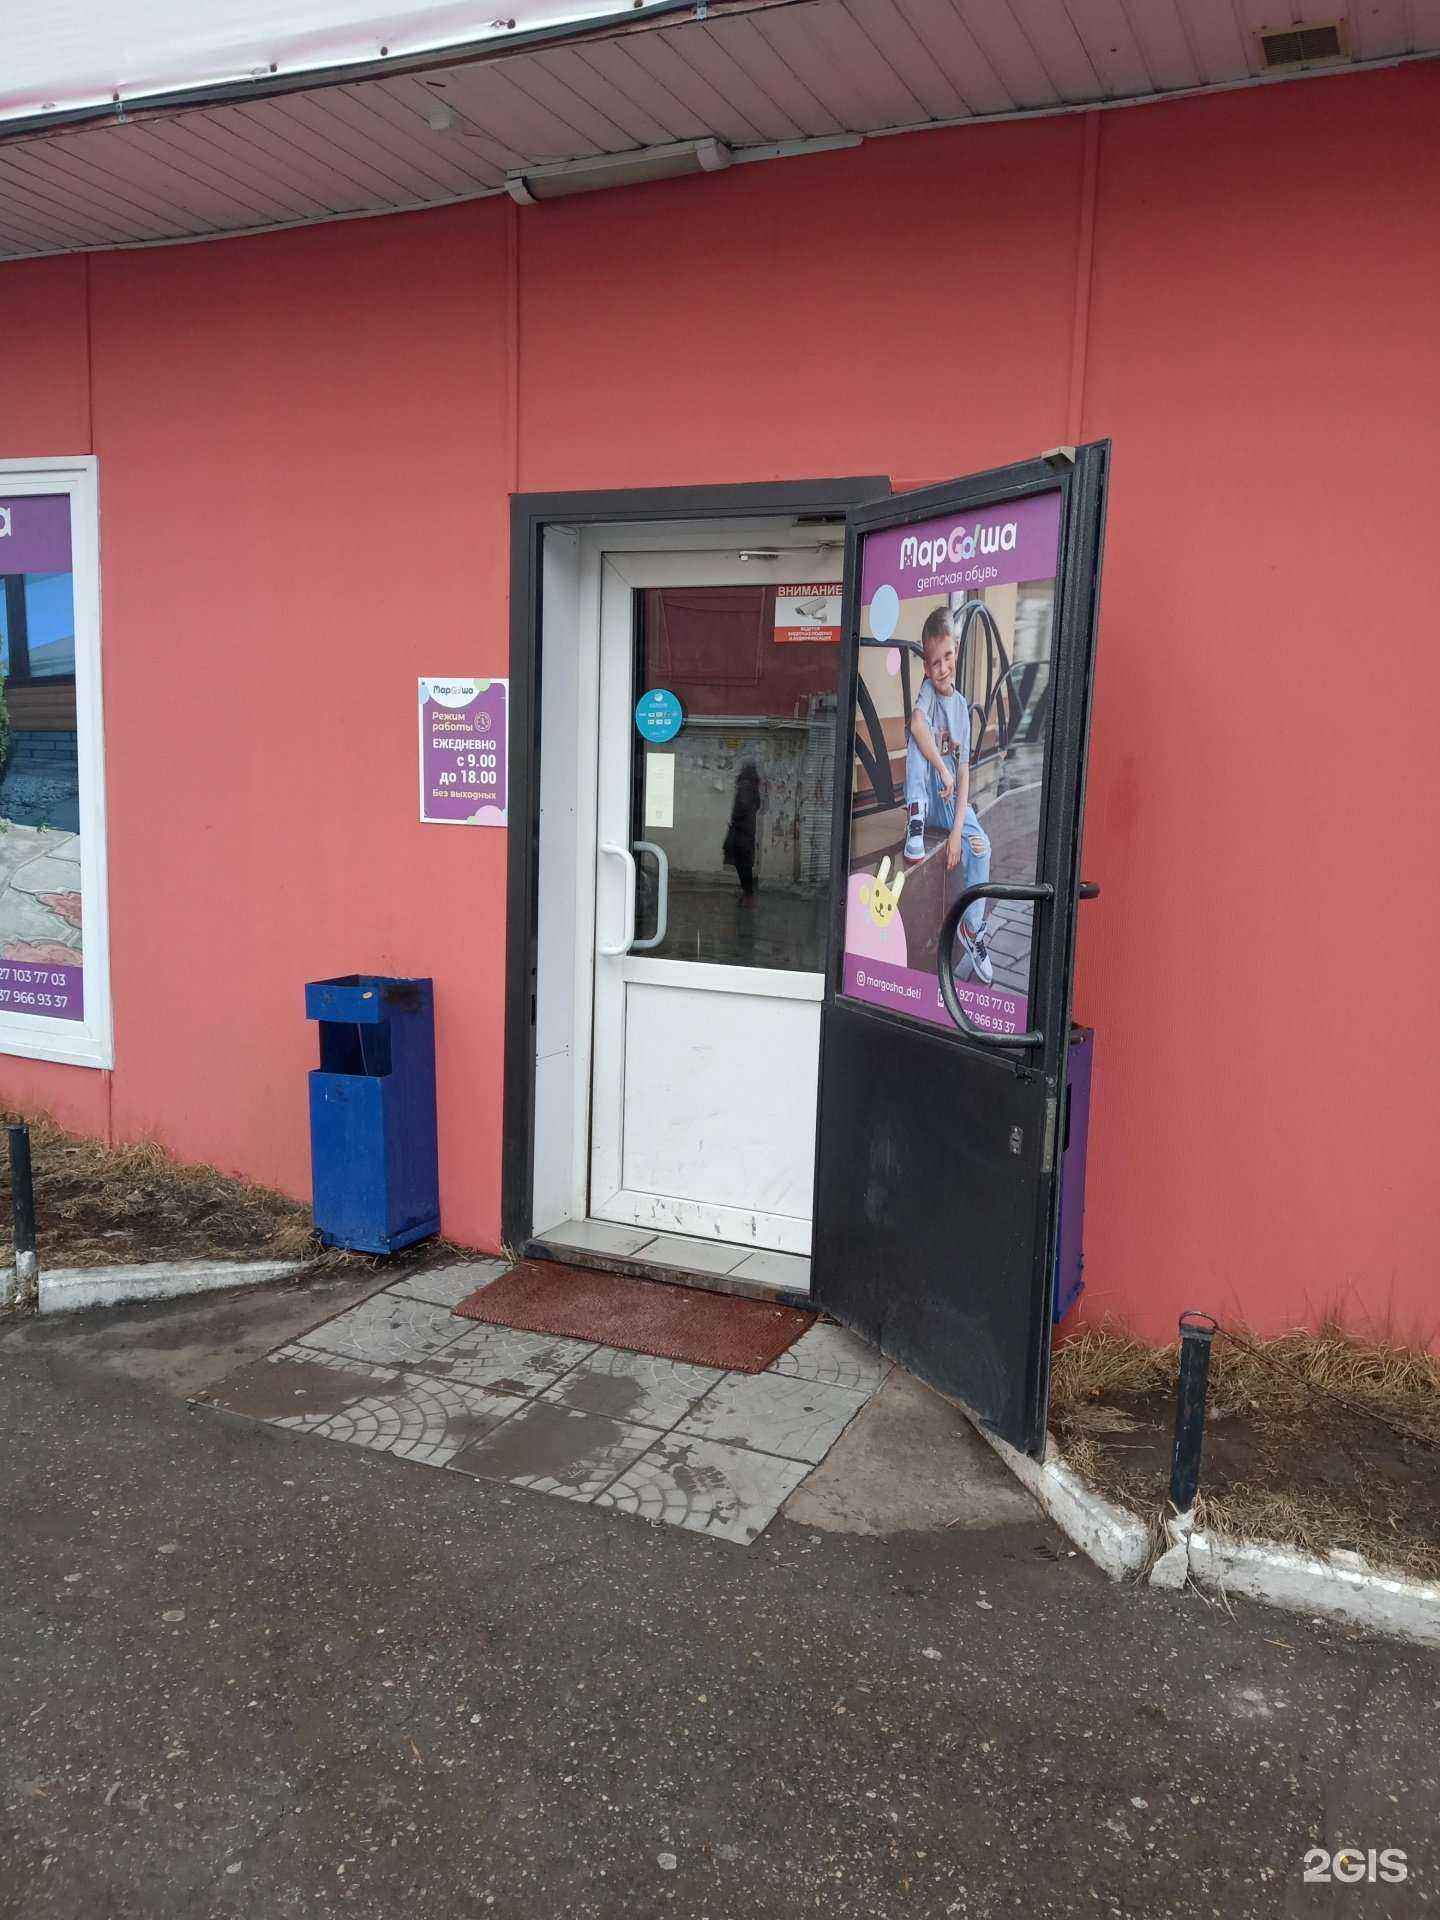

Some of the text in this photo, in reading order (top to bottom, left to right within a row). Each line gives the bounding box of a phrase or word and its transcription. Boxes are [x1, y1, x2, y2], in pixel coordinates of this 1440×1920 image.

[917, 565, 998, 592] детская обувь
[778, 584, 843, 596] ВНИМАНИЕ
[432, 711, 466, 721] Режим
[432, 721, 473, 732] работы
[432, 738, 496, 751] ЕЖЕДНЕВНО
[467, 754, 496, 768] 9.00
[439, 770, 497, 785] до 18.00
[432, 788, 497, 800] Без выходных
[12, 969, 32, 982] 103
[33, 971, 49, 984] 77
[50, 973, 66, 986] 03
[866, 976, 922, 999] margosha_deti
[13, 991, 36, 1004] 966
[37, 993, 52, 1006] 93
[53, 995, 68, 1008] 37
[959, 989, 974, 1003] 927
[976, 993, 990, 1007] 103
[991, 997, 1003, 1010] 77
[1003, 1001, 1015, 1014] 03
[974, 1013, 991, 1027] 966
[992, 1018, 1003, 1031] 93
[1004, 1021, 1016, 1034] 37
